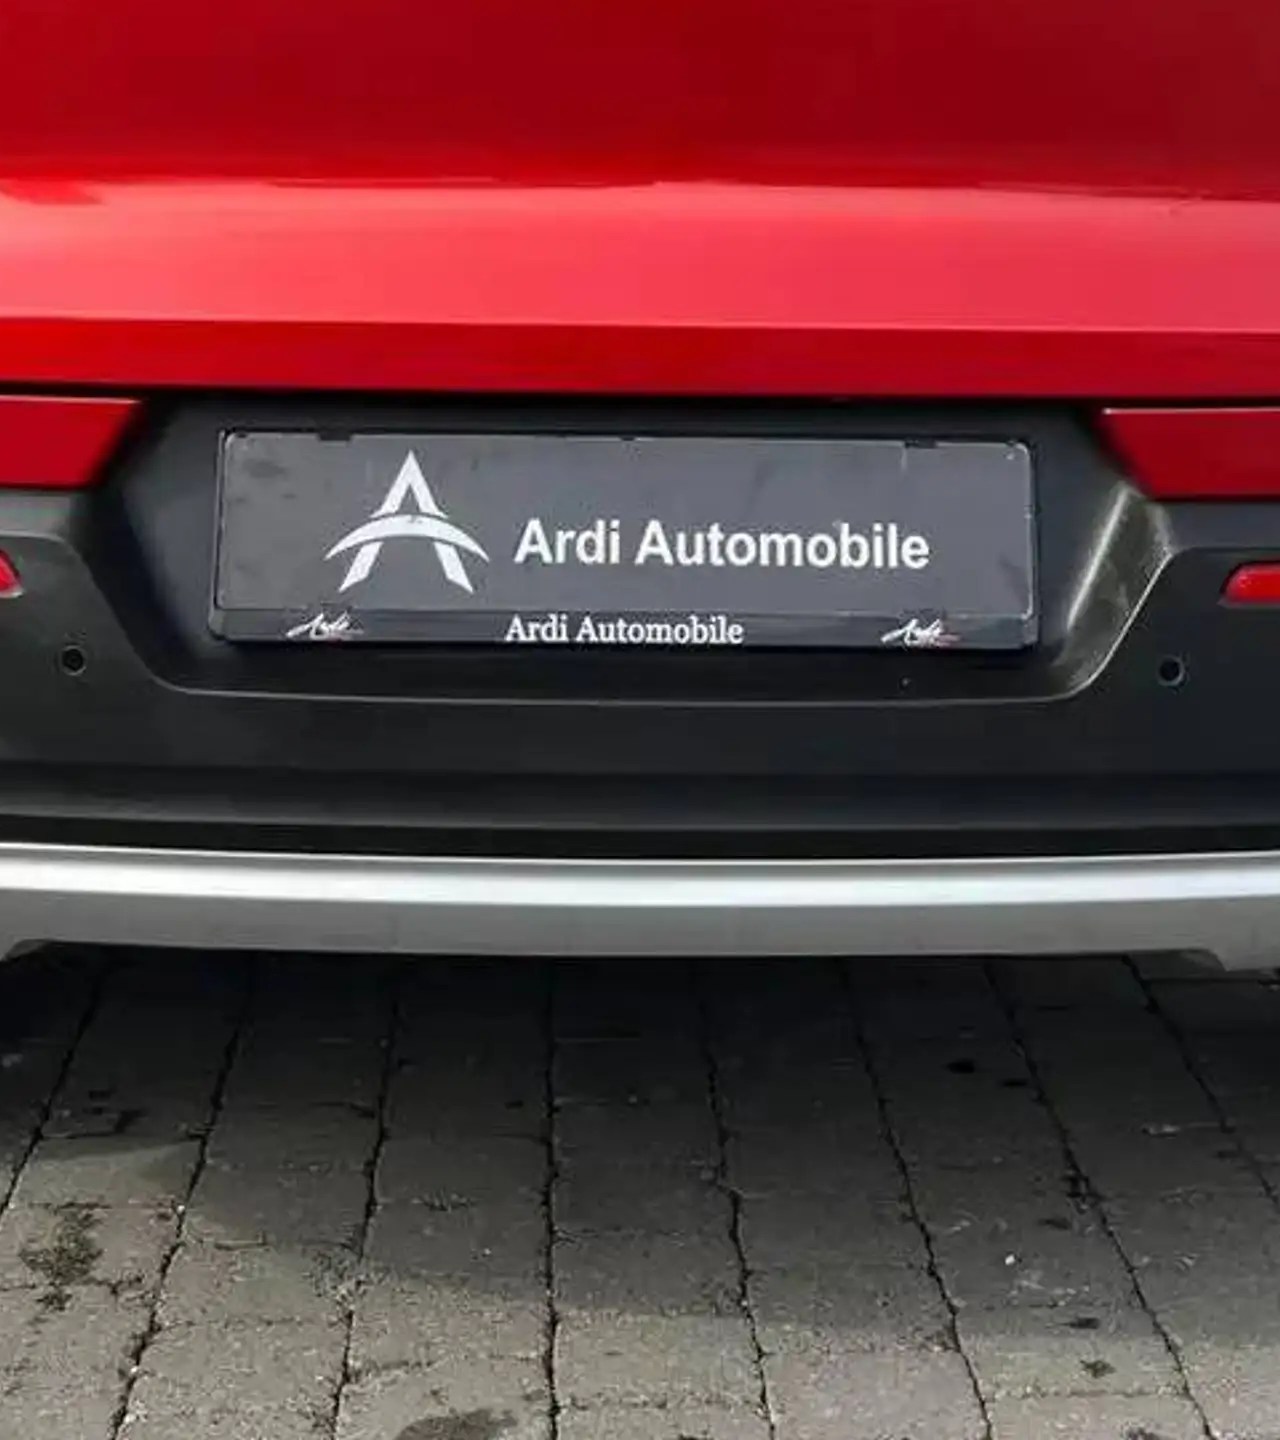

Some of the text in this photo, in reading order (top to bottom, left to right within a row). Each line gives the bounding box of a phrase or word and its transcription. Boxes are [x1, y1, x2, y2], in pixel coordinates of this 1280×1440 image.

[513, 517, 931, 571] Ardi Automobile
[505, 613, 744, 645] Ardi Automobile
